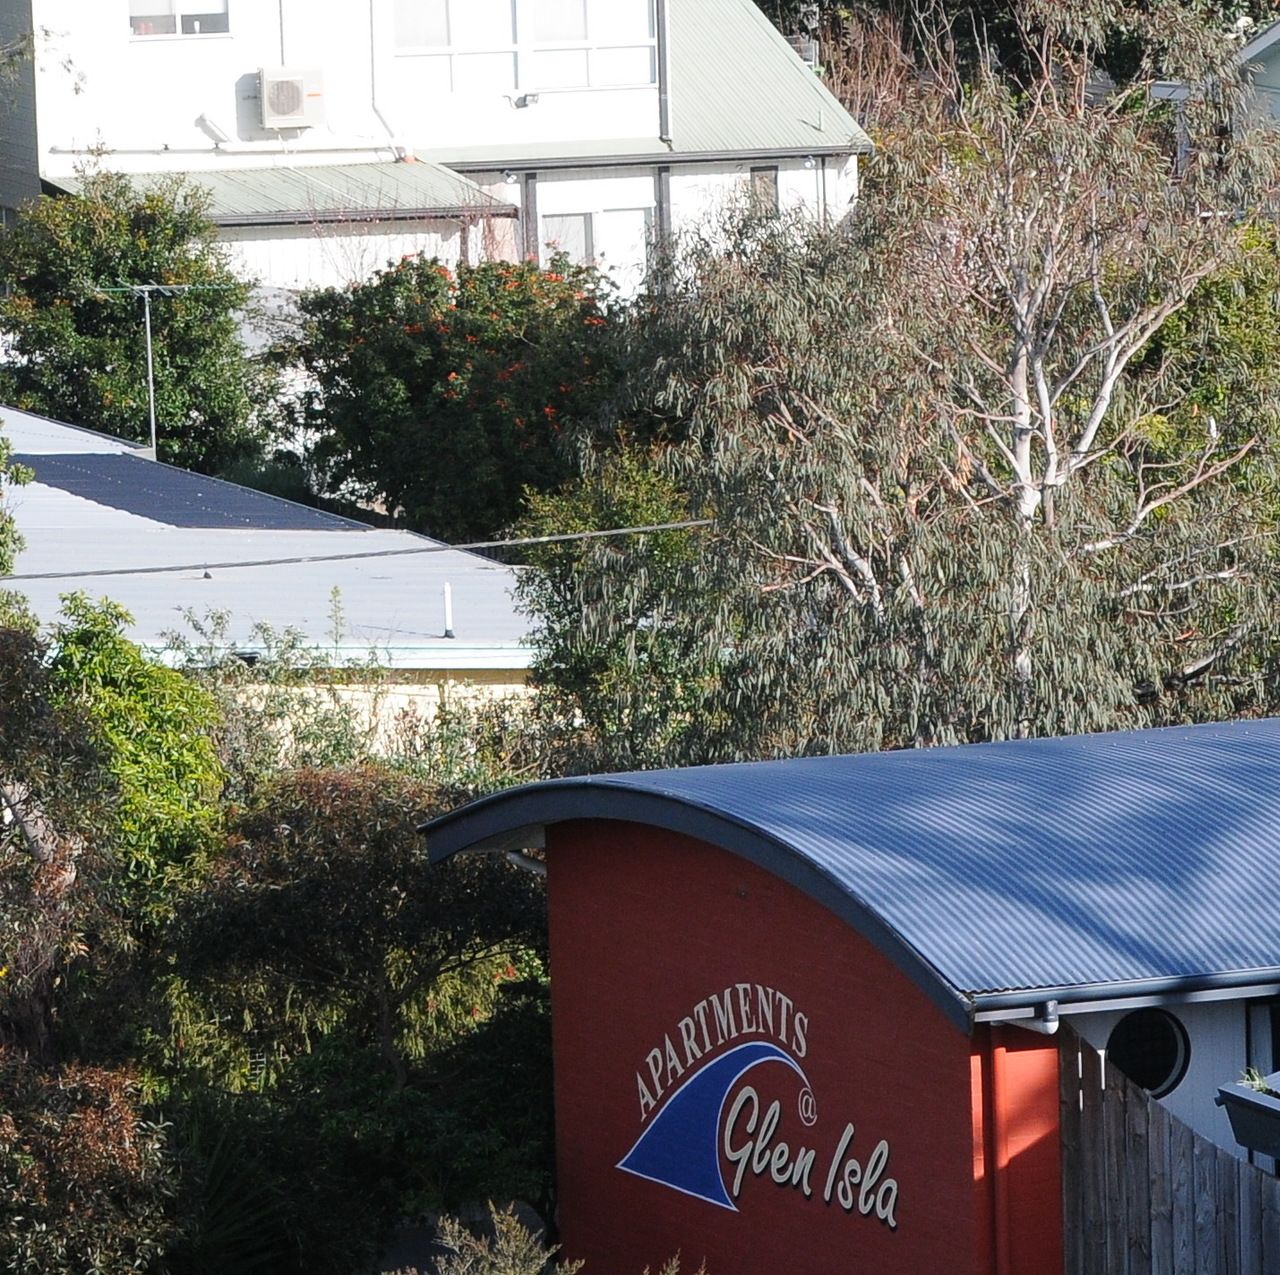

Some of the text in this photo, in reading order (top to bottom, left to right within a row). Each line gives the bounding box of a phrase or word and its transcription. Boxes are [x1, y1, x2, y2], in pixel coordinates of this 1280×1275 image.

[636, 983, 809, 1122] APARTMENTS
[798, 1087, 817, 1126] @
[724, 1086, 899, 1229] Glen Isla
